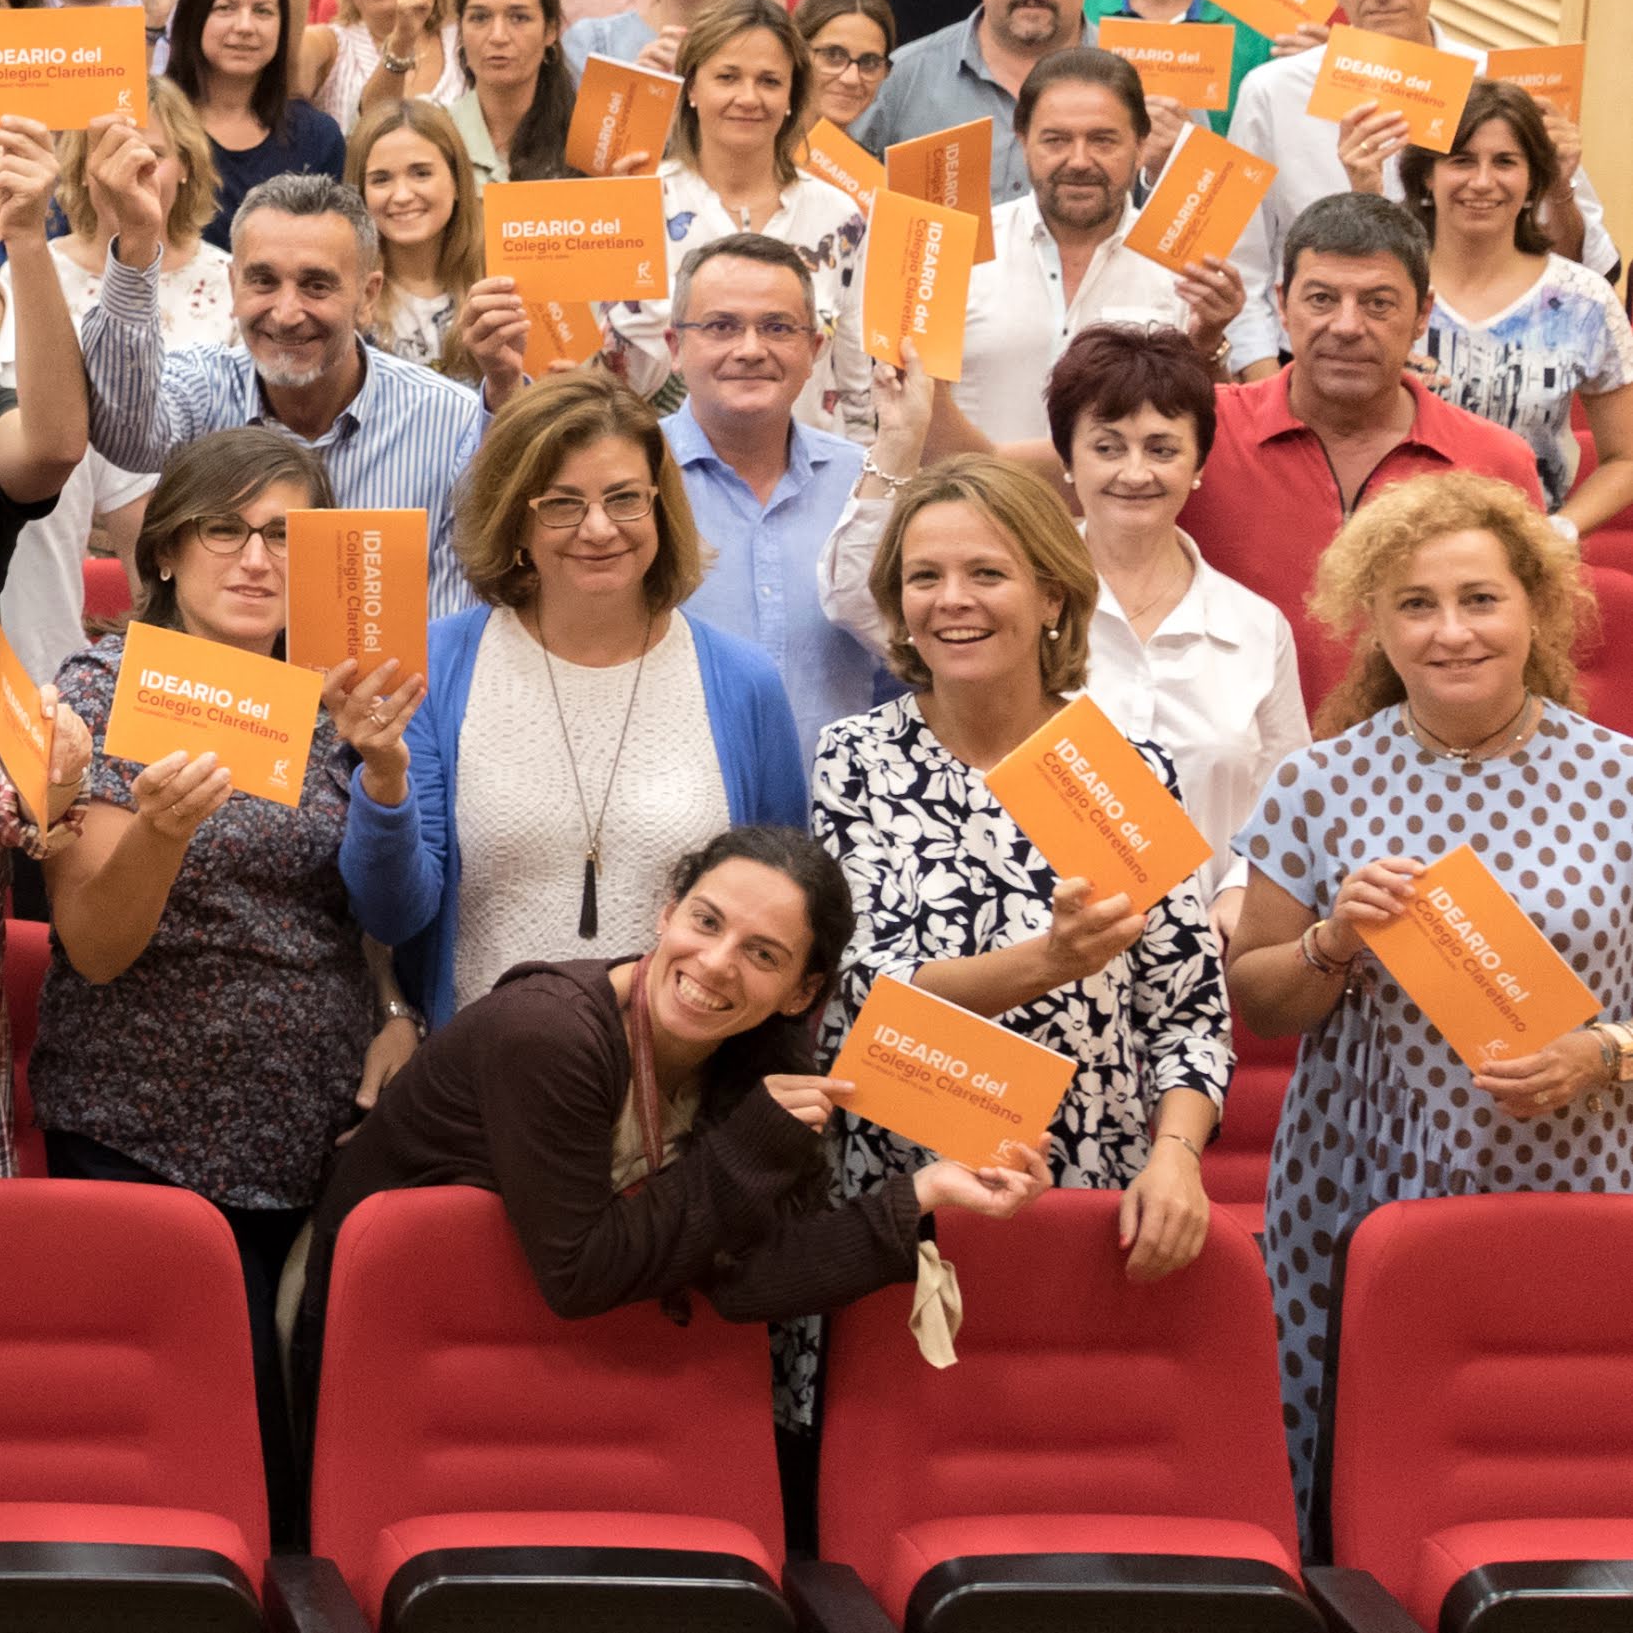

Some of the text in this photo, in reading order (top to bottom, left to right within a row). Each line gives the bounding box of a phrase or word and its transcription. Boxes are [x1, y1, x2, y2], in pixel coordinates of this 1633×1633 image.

[45, 65, 125, 79] Claretiano
[71, 47, 102, 64] del
[1333, 55, 1432, 92] IDEARIO del
[501, 218, 621, 238] IDEARIO del
[502, 237, 644, 254] Colegio Claretiano
[908, 218, 927, 272] Colegio
[1157, 167, 1217, 253] IDEARIO del
[911, 220, 942, 335] IDEARIO del
[343, 531, 362, 657] Colegio Claretia
[362, 531, 381, 653] IDEARIO del
[137, 689, 291, 744] Colegio Claretiano
[139, 668, 272, 721] IDEARIO del
[1042, 752, 1149, 885] Colegio Claretiano
[1052, 737, 1153, 855] IDEARIO del
[1413, 900, 1525, 1034] Colegio Claretiano
[1425, 886, 1531, 1005] IDEARIO del
[867, 1044, 1022, 1125] Colegio Claretiano
[872, 1024, 1010, 1100] IDEARIO del
